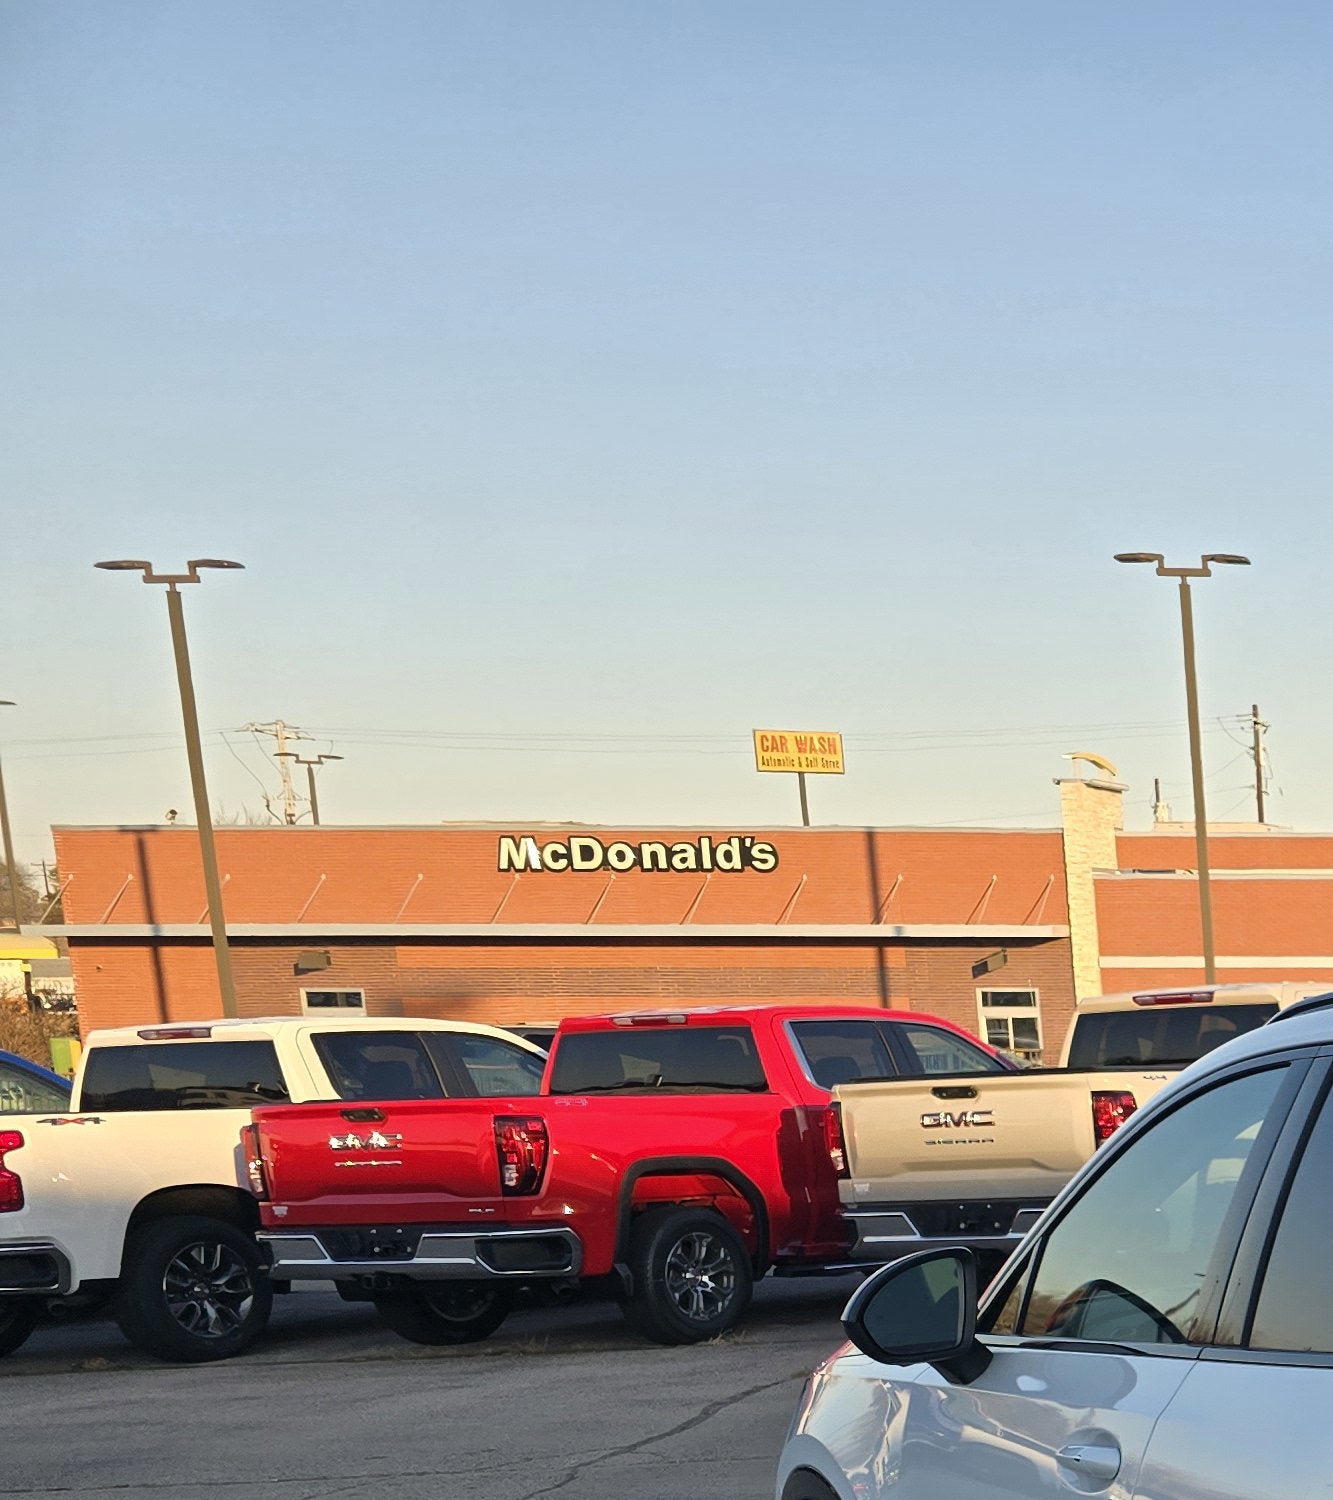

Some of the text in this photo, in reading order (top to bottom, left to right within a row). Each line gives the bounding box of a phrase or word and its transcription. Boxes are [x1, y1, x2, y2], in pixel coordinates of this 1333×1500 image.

[760, 734, 837, 754] CAR WASH
[761, 755, 795, 767] Automatic
[498, 836, 779, 872] McDonald's
[920, 1109, 996, 1128] GMC
